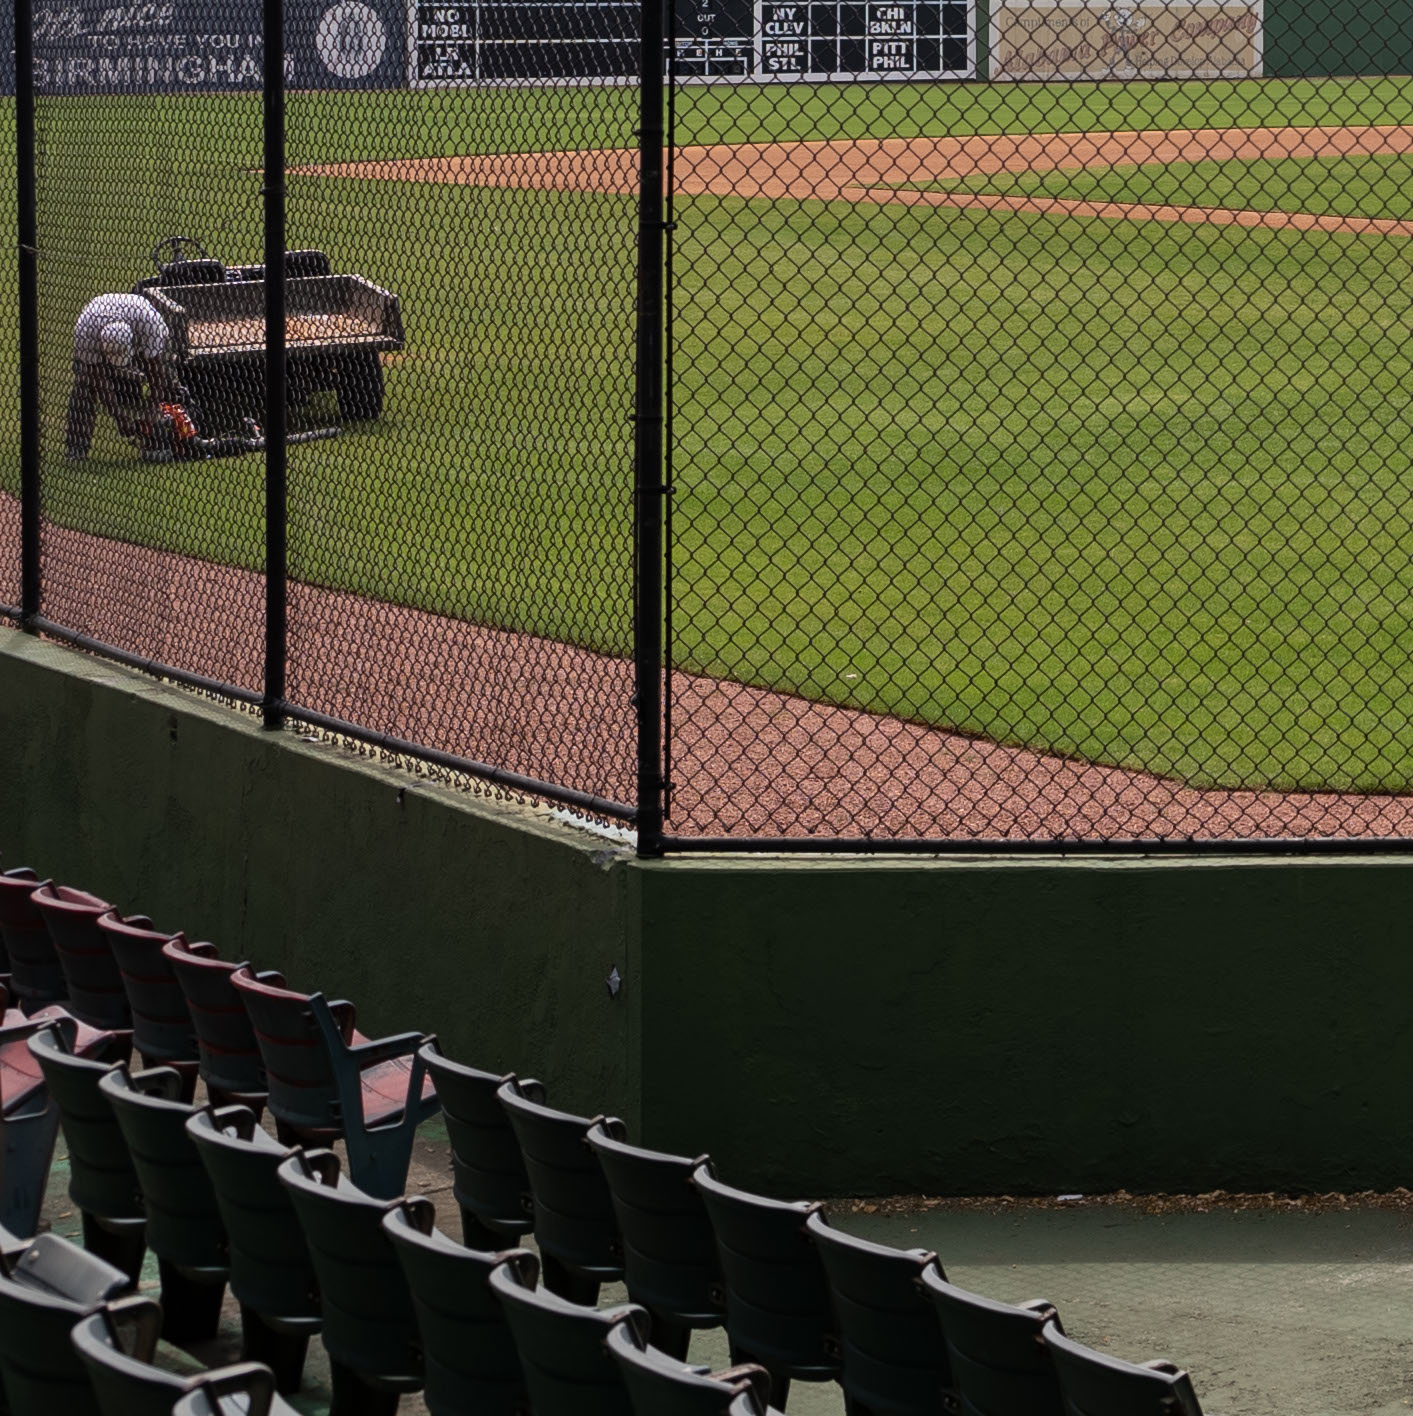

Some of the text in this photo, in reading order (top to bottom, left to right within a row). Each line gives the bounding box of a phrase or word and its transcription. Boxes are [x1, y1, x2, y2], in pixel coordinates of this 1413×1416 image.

[772, 8, 797, 21] NY
[876, 7, 905, 20] CHI
[764, 22, 805, 35] CLEV
[87, 34, 120, 50] TO
[127, 34, 187, 50] HAVE
[198, 33, 240, 49] YOU
[765, 43, 805, 57] PHIL
[872, 42, 910, 55] PITT
[768, 57, 802, 70] STL
[872, 56, 911, 69] PHIL
